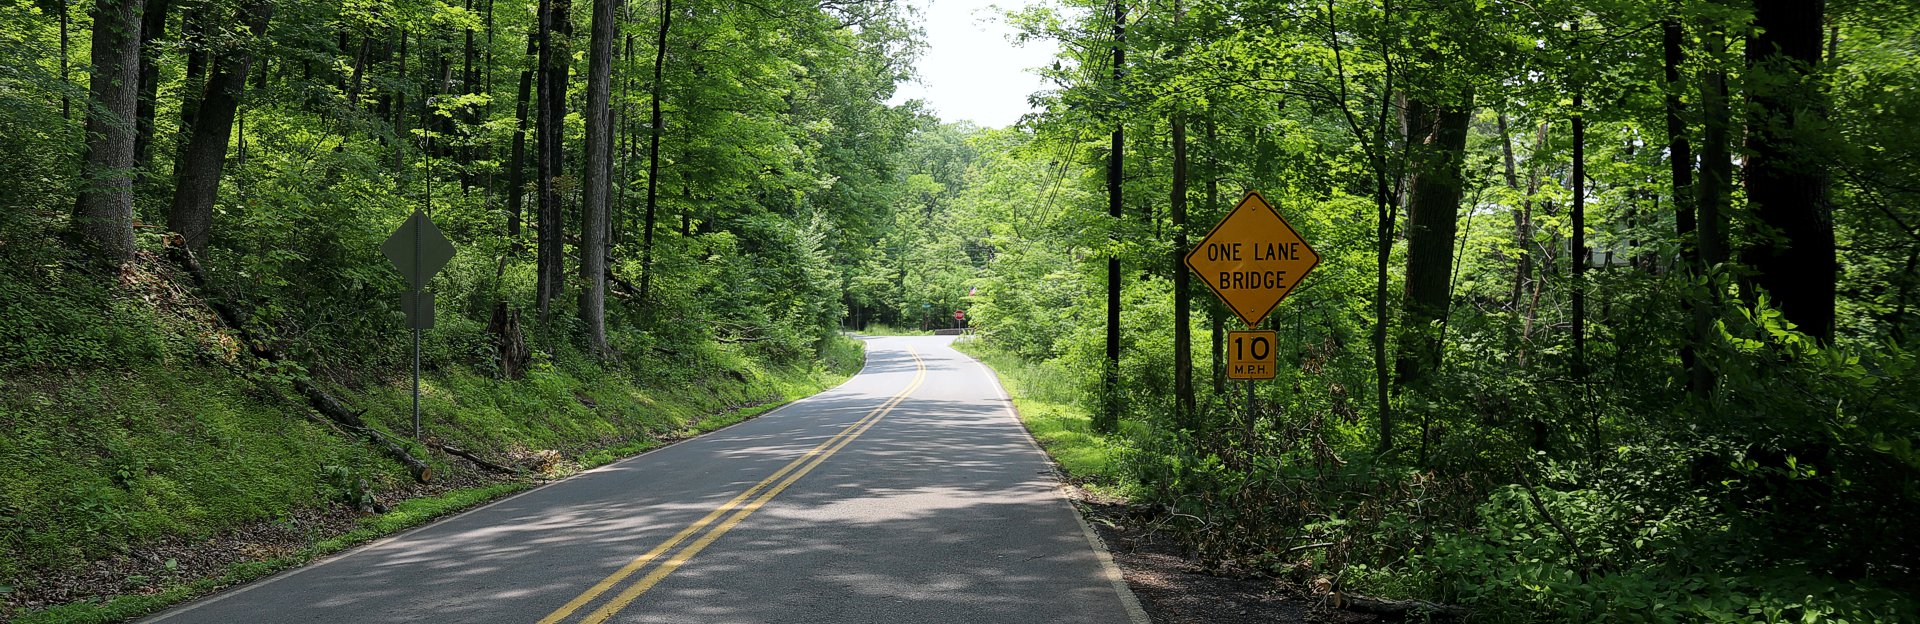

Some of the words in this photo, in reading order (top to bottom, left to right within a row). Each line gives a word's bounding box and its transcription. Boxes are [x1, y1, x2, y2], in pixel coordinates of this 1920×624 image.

[1207, 243, 1242, 262] ONE
[1254, 242, 1300, 261] LANE
[1219, 271, 1287, 290] BRIDGE
[1234, 336, 1270, 360] 10
[1234, 364, 1269, 375] M.P.H.
